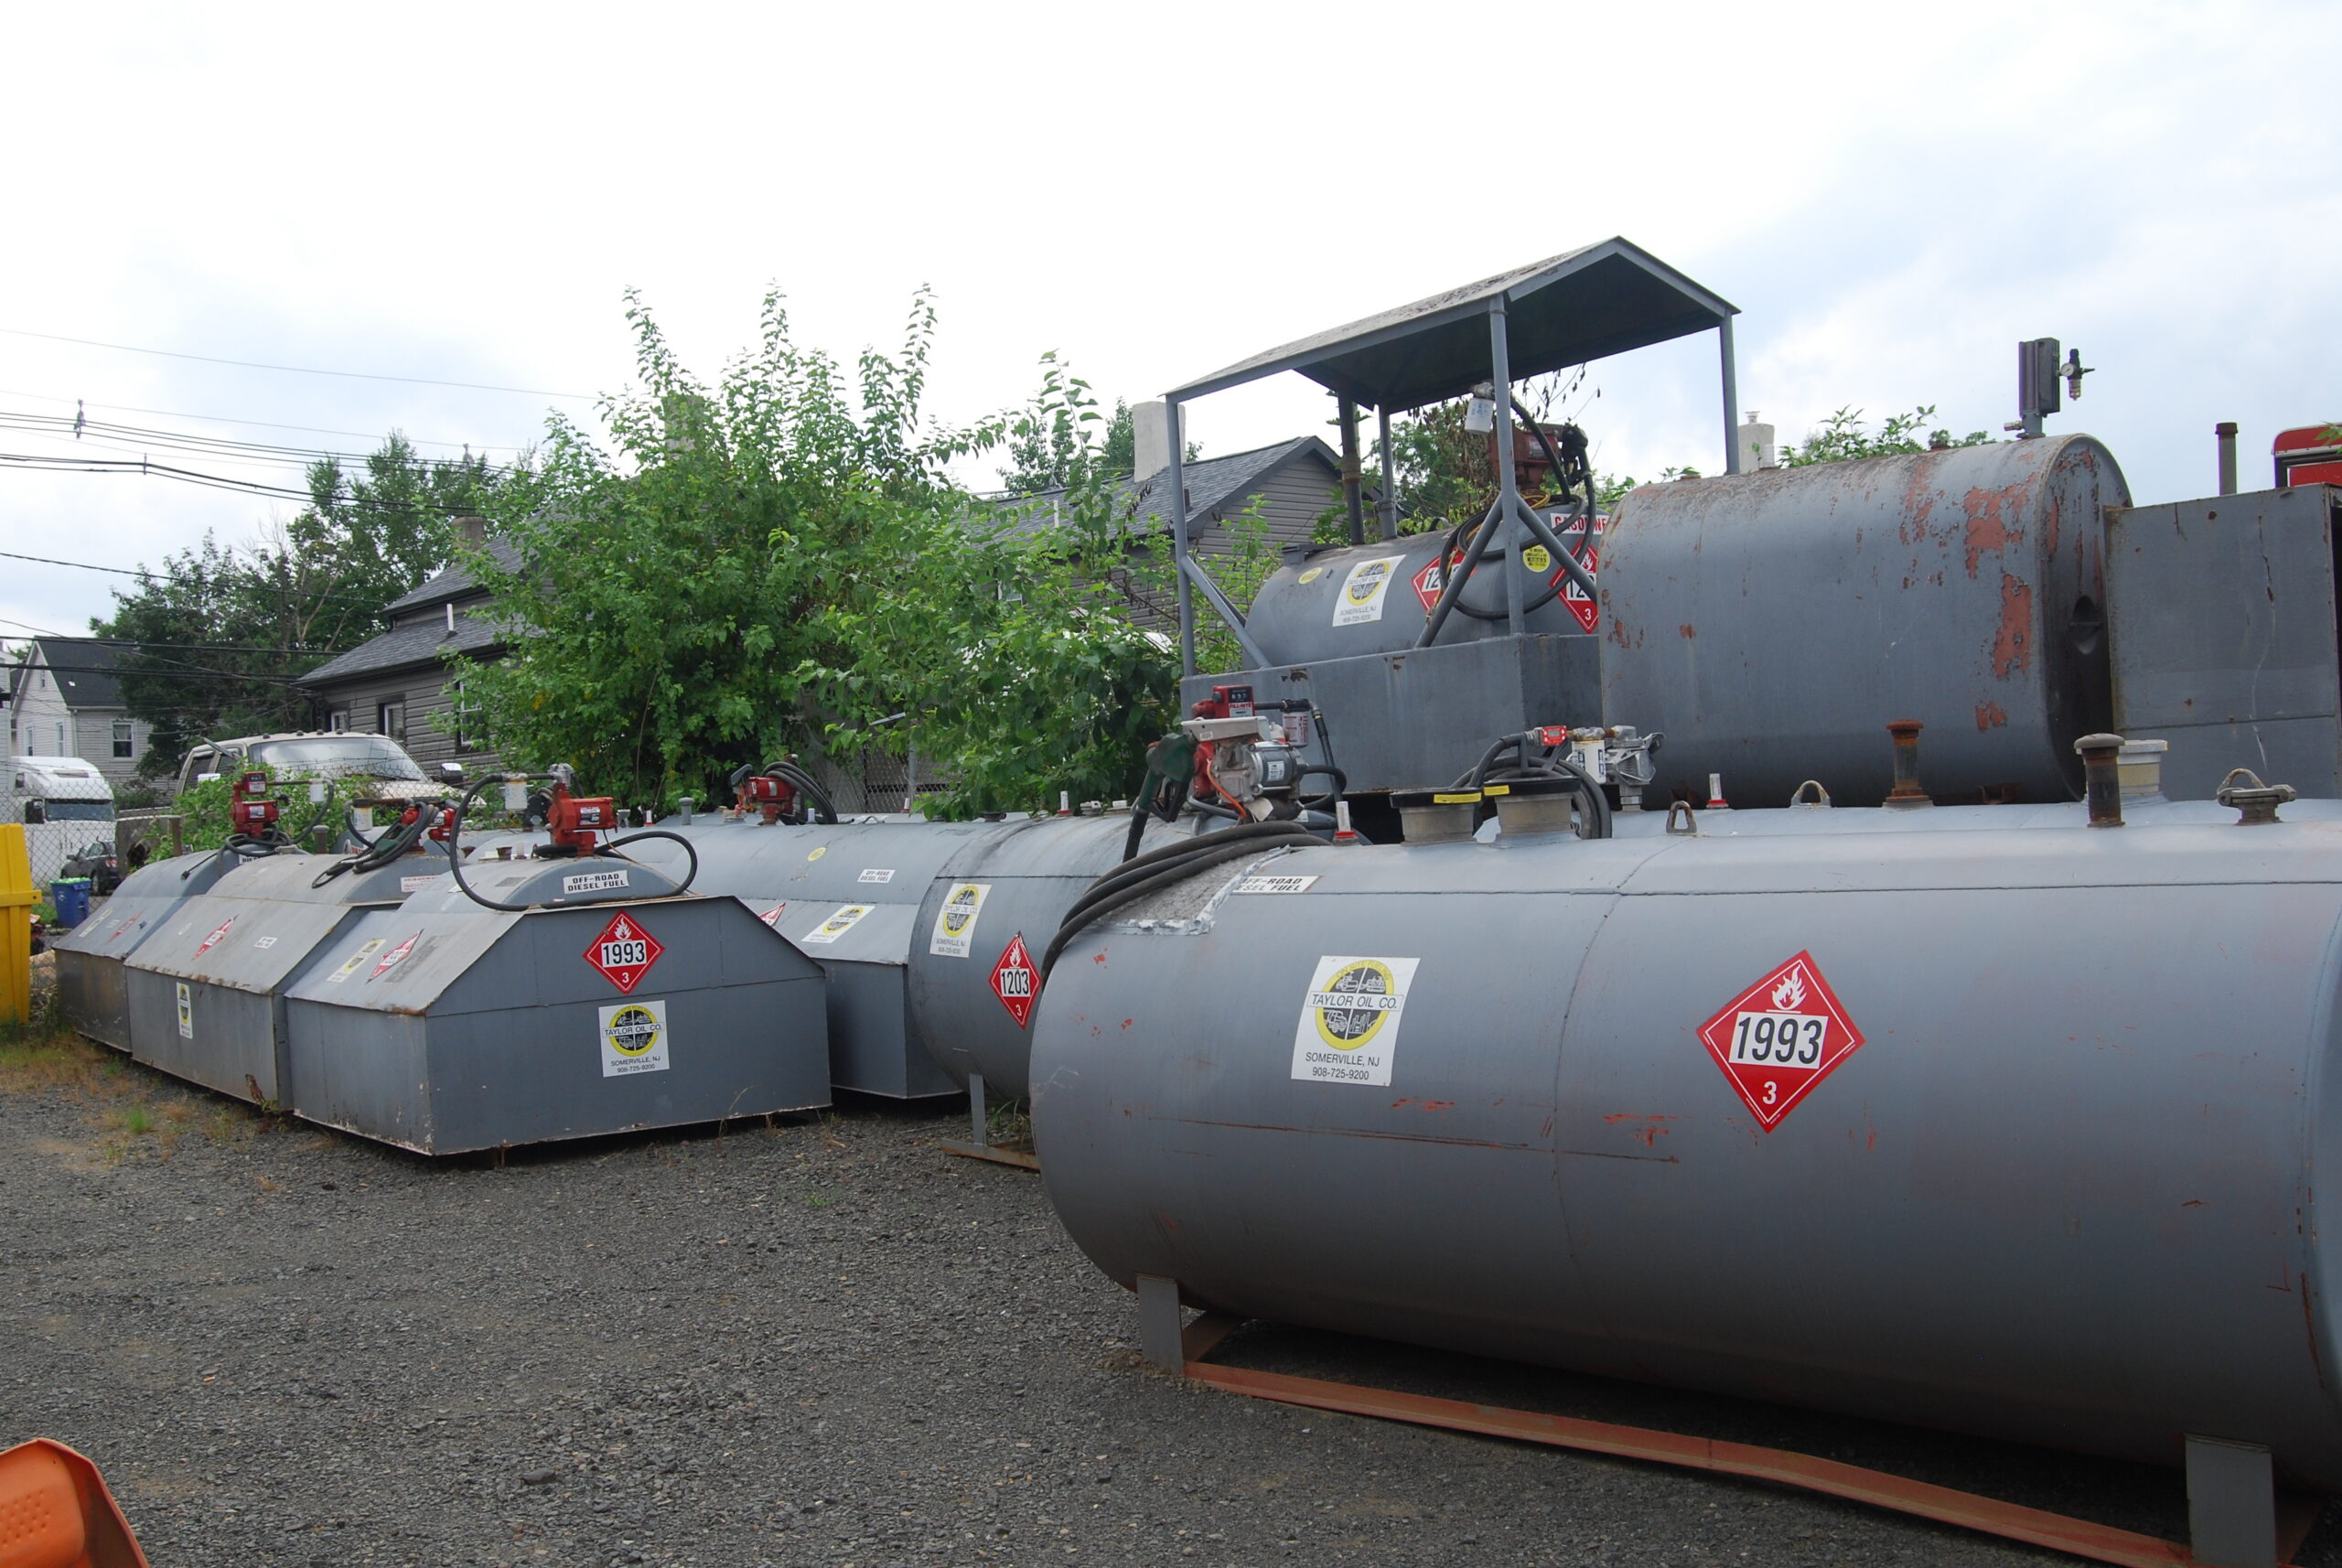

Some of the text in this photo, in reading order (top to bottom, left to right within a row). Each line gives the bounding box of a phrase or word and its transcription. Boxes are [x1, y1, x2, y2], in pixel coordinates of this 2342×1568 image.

[1585, 608, 1592, 620] 3
[573, 874, 619, 884] OFF-ROAD
[568, 883, 600, 892] DIESEL
[603, 942, 645, 965] 1993
[622, 972, 629, 983] 3
[1002, 971, 1029, 995] 1203
[1312, 994, 1397, 1009] TAYLOR OIL CO.
[1015, 1004, 1023, 1016] 3
[605, 1027, 633, 1036] TAYLOR
[1737, 1016, 1822, 1065] 1993
[1305, 1052, 1380, 1067] SOMERVILLE, NJ
[1312, 1067, 1370, 1080] 908-725-9200
[1762, 1080, 1778, 1105] 3
